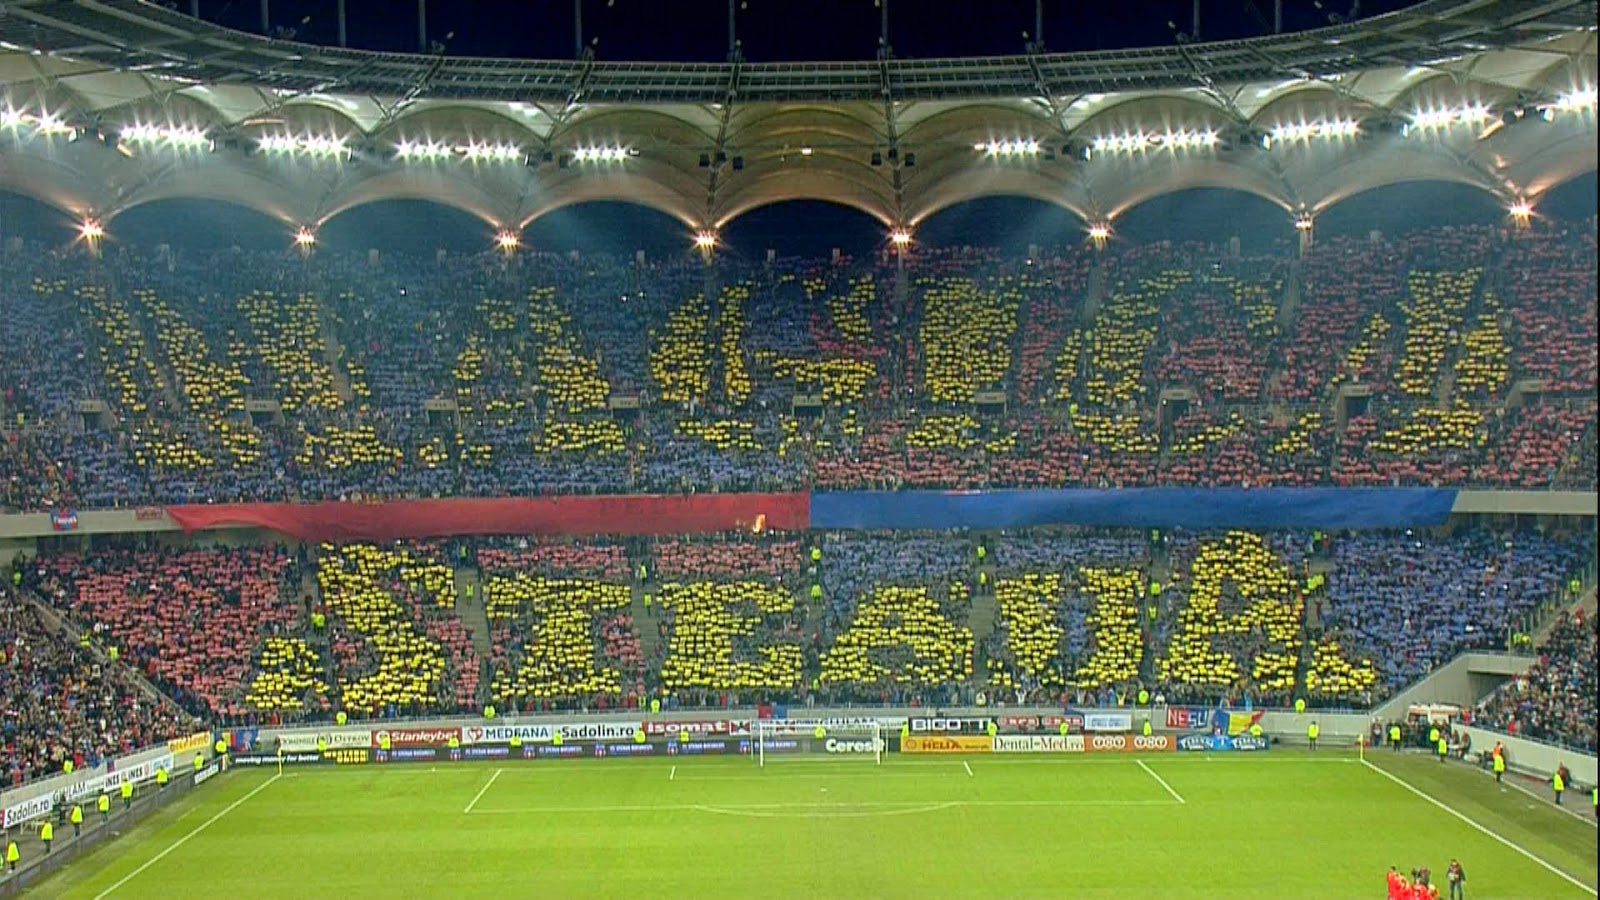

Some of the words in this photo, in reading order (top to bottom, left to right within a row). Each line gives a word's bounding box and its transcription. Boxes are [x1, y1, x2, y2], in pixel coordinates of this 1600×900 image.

[245, 529, 1378, 712] STEAUA
[1168, 709, 1208, 728] NESU
[562, 724, 634, 738] Sadolin.ro
[994, 737, 1084, 751] Dental-Med.ro
[7, 799, 49, 826] Sadolin.ro
